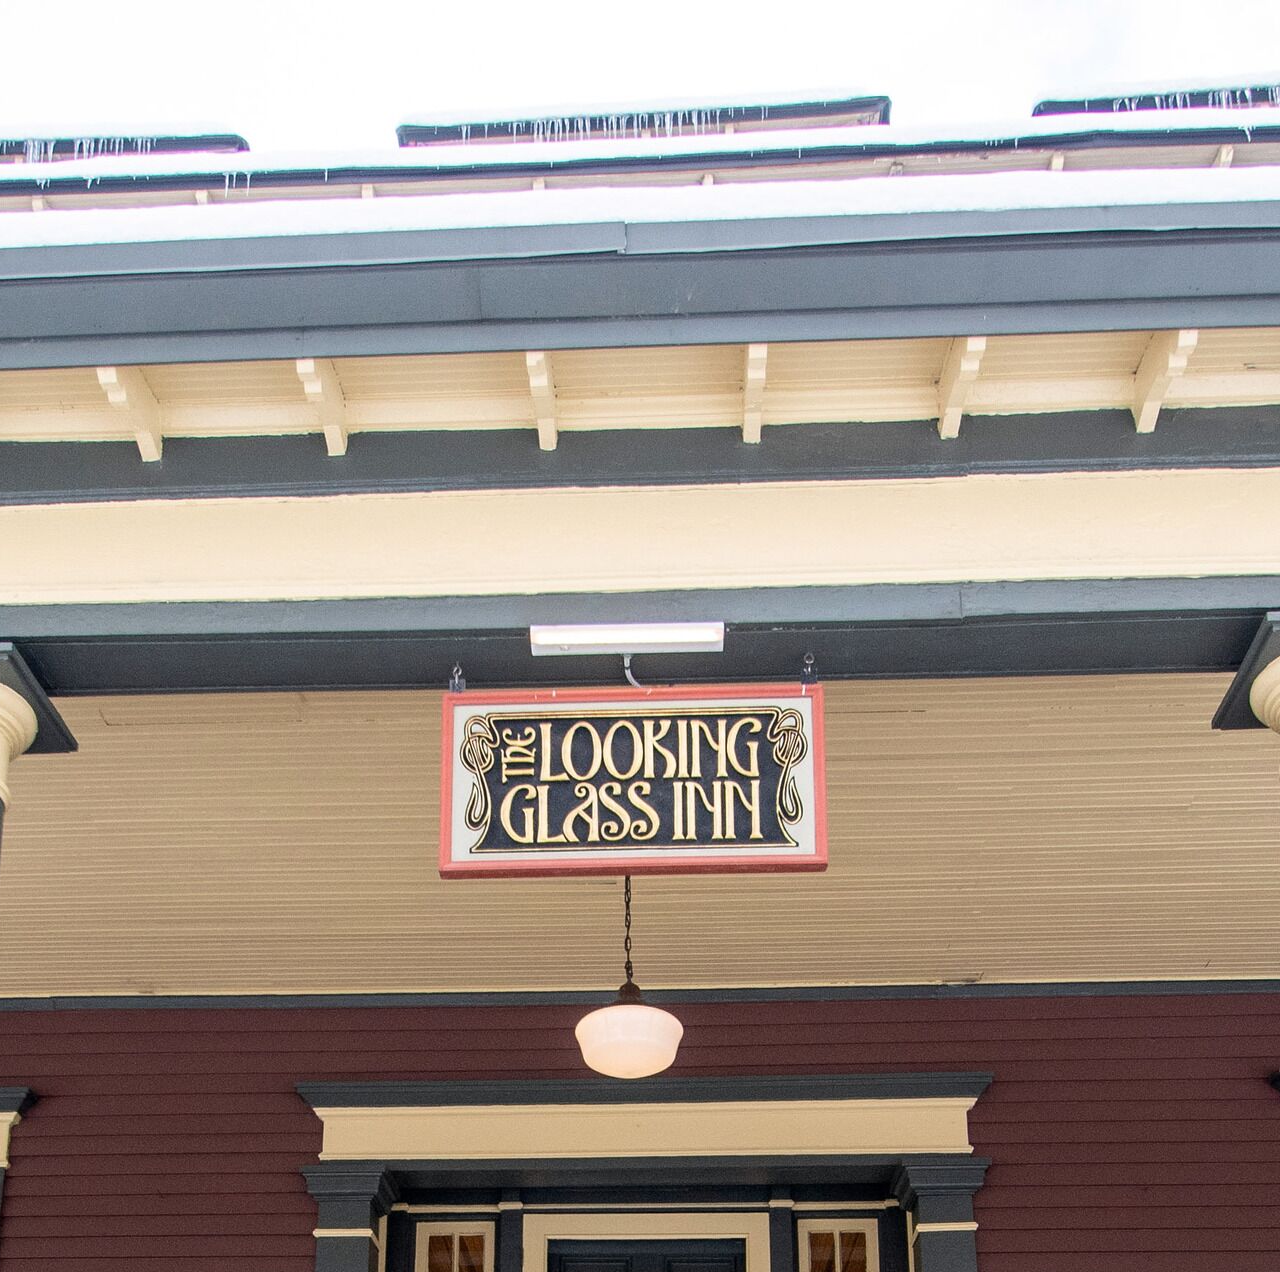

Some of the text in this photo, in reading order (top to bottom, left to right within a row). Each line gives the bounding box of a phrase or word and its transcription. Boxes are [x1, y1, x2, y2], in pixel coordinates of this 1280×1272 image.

[501, 726, 537, 783] THE
[539, 717, 763, 782] LOOKING
[500, 779, 765, 844] GLASS INN
